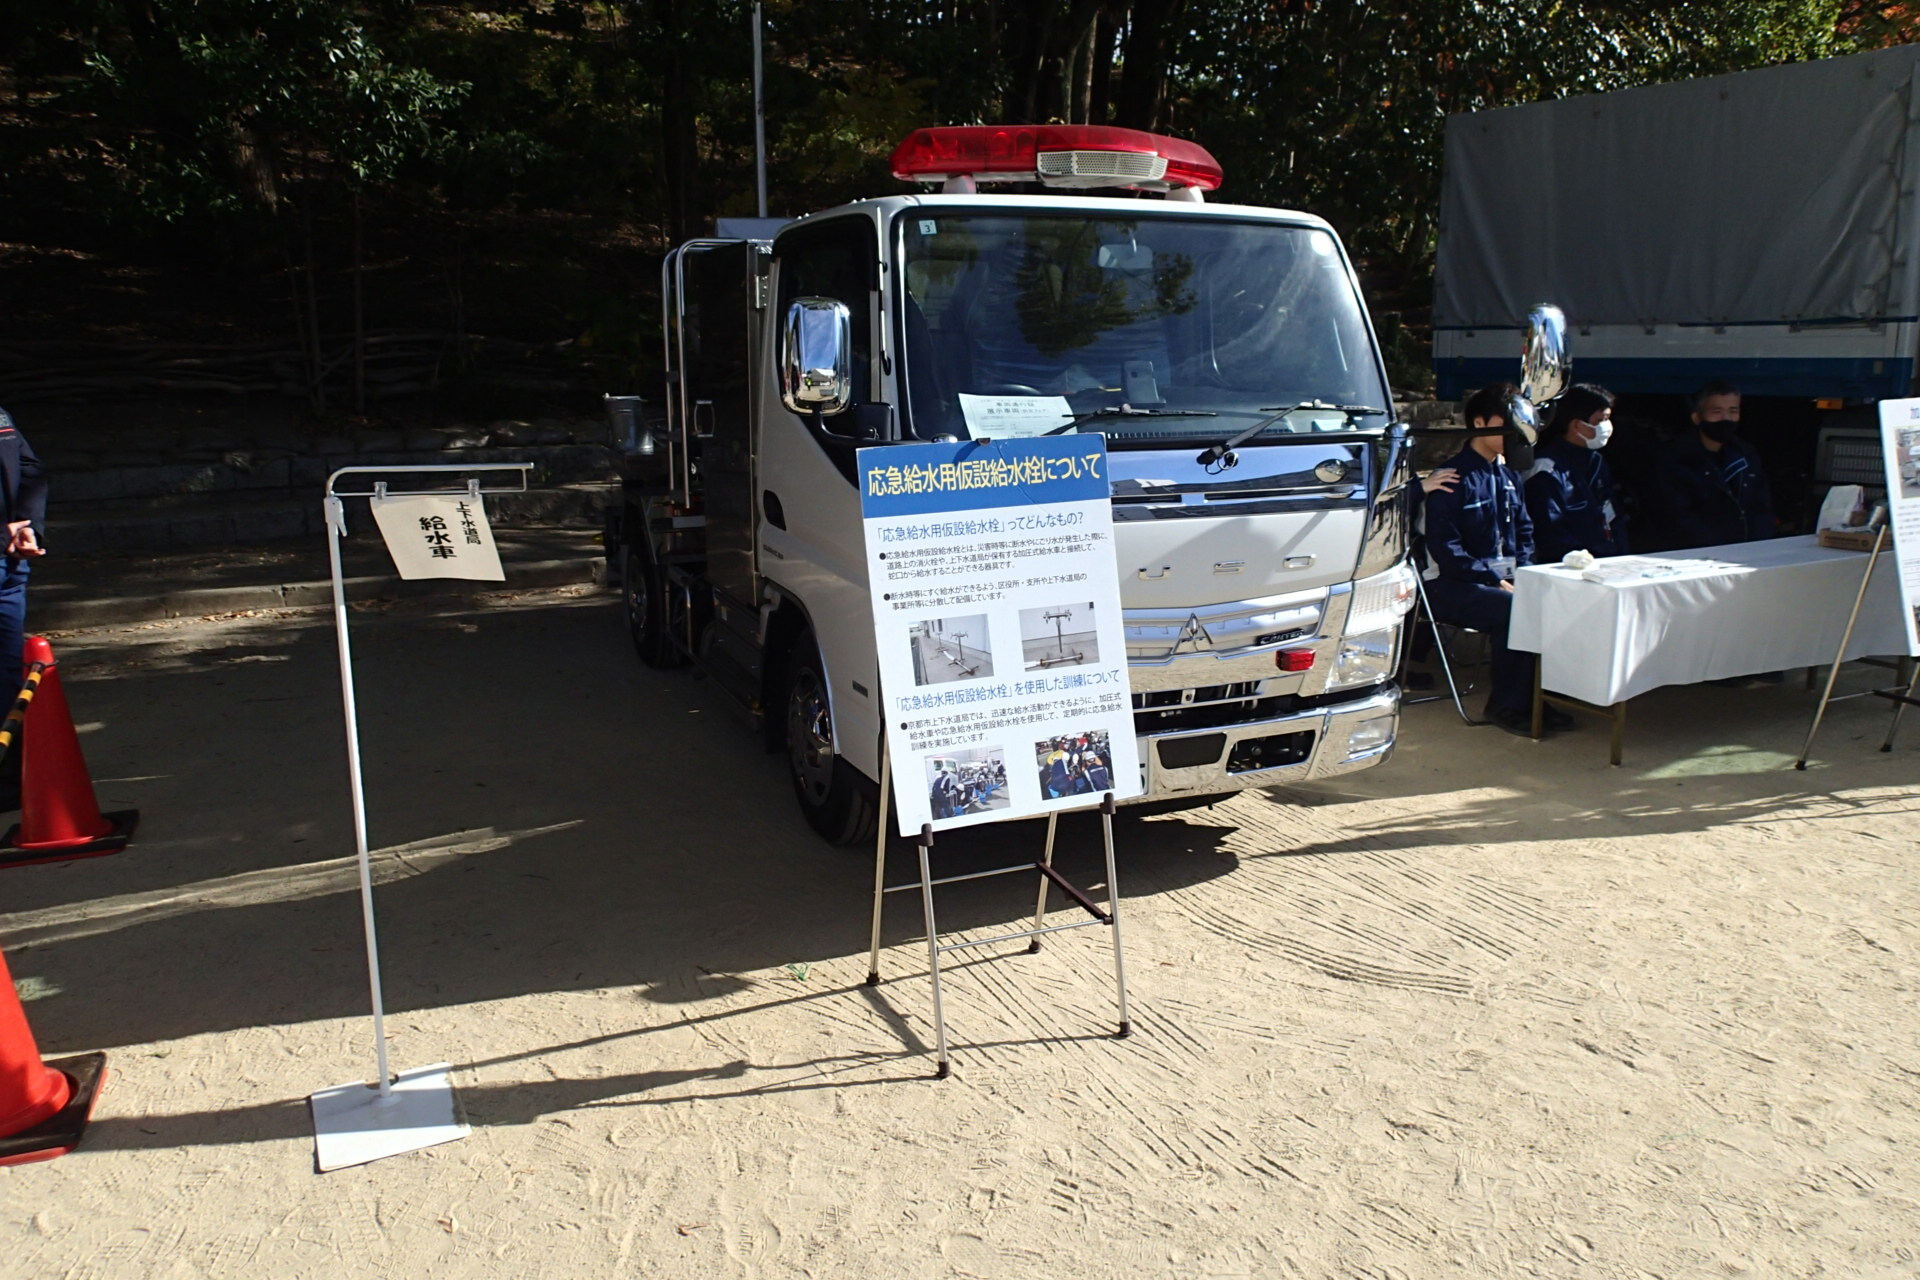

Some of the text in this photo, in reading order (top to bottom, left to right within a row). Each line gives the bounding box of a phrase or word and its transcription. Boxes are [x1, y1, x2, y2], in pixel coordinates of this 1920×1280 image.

[868, 453, 1102, 496] 応急給水用仮設給水栓について
[419, 515, 457, 559] 給水車
[456, 501, 481, 545] 上下水道局
[1138, 554, 1316, 581] USO
